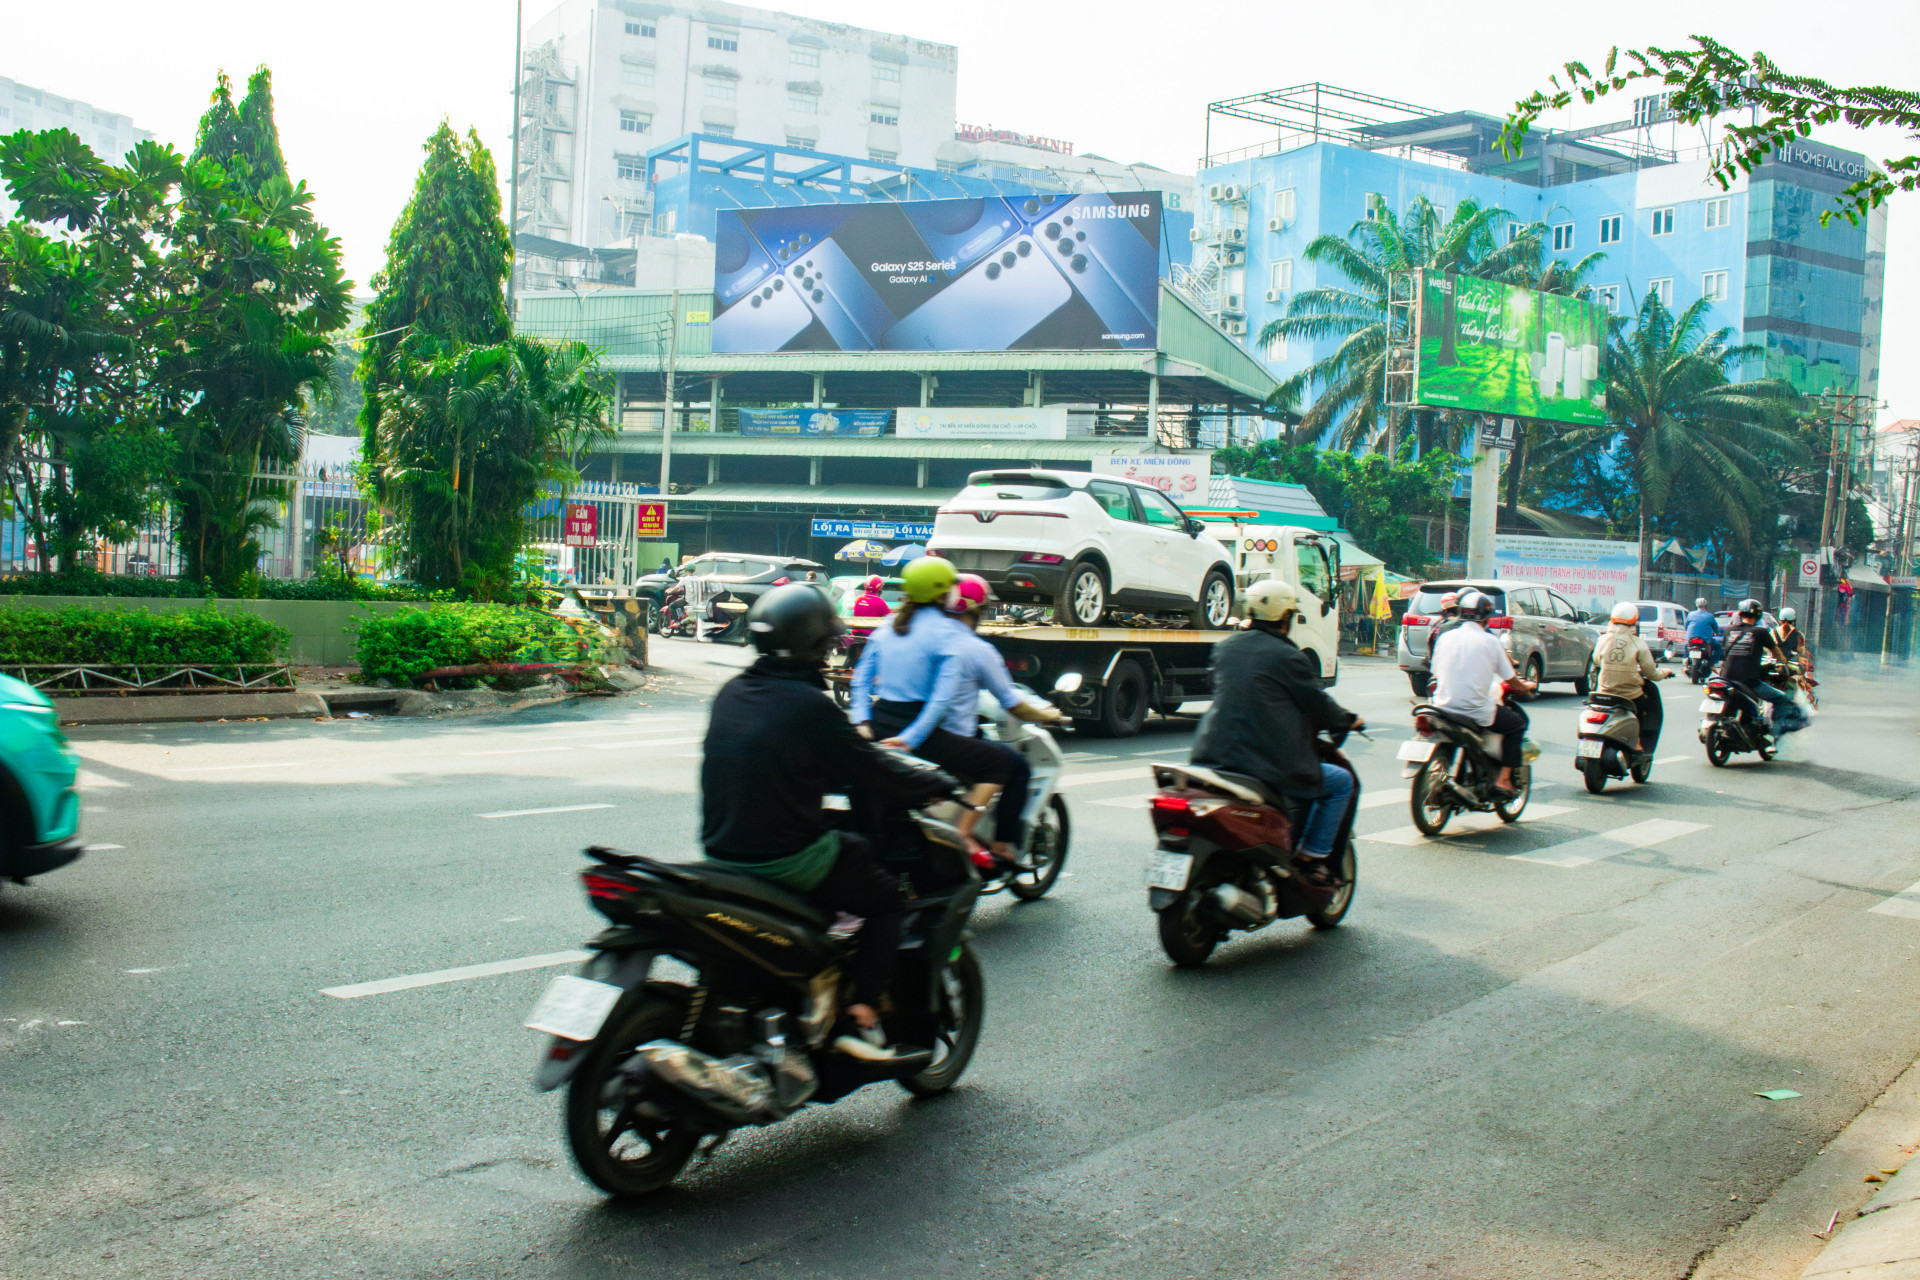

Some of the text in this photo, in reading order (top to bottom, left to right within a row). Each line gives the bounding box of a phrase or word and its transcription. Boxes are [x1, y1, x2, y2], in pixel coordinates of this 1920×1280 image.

[1027, 135, 1074, 155] MINH
[1795, 148, 1845, 173] HOMETALK
[1071, 203, 1150, 220] SAMSUNG
[871, 259, 957, 273] Galaxy S25 Series
[889, 275, 928, 285] Galaxy AI
[1429, 278, 1452, 290] wells
[1101, 333, 1145, 341] samsung.com
[1129, 457, 1142, 466] XE
[1167, 456, 1191, 466] ĐÔNG
[1179, 473, 1197, 492] 3
[835, 524, 850, 532] RA
[915, 526, 935, 535] VÀO
[867, 543, 884, 552] be
[1610, 570, 1628, 581] MINH
[1587, 584, 1597, 595] AN
